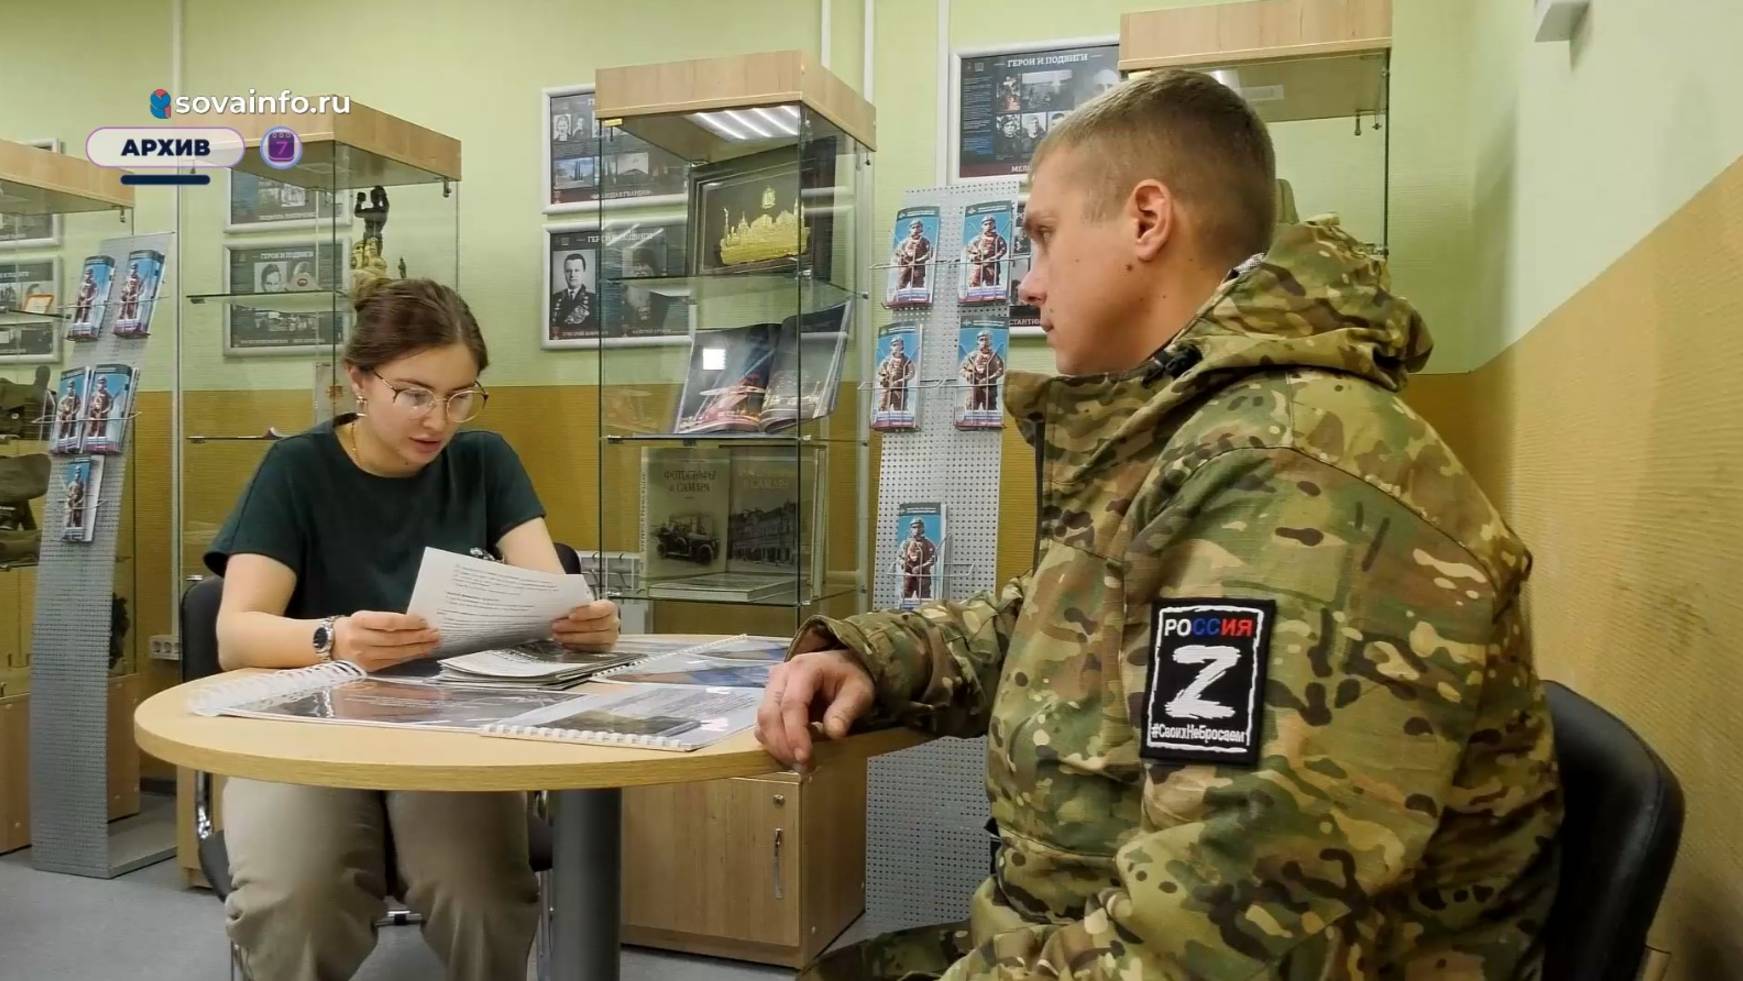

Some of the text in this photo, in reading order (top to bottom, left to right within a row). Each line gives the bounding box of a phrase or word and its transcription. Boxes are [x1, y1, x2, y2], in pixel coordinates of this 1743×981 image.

[1007, 57, 1036, 68] ГЕРОИ
[1045, 53, 1089, 65] ПОДВИГИ
[1164, 617, 1254, 637] РОССИЯ
[1164, 644, 1242, 720] Z
[1151, 722, 1246, 744] #СвоихНеБросаем
